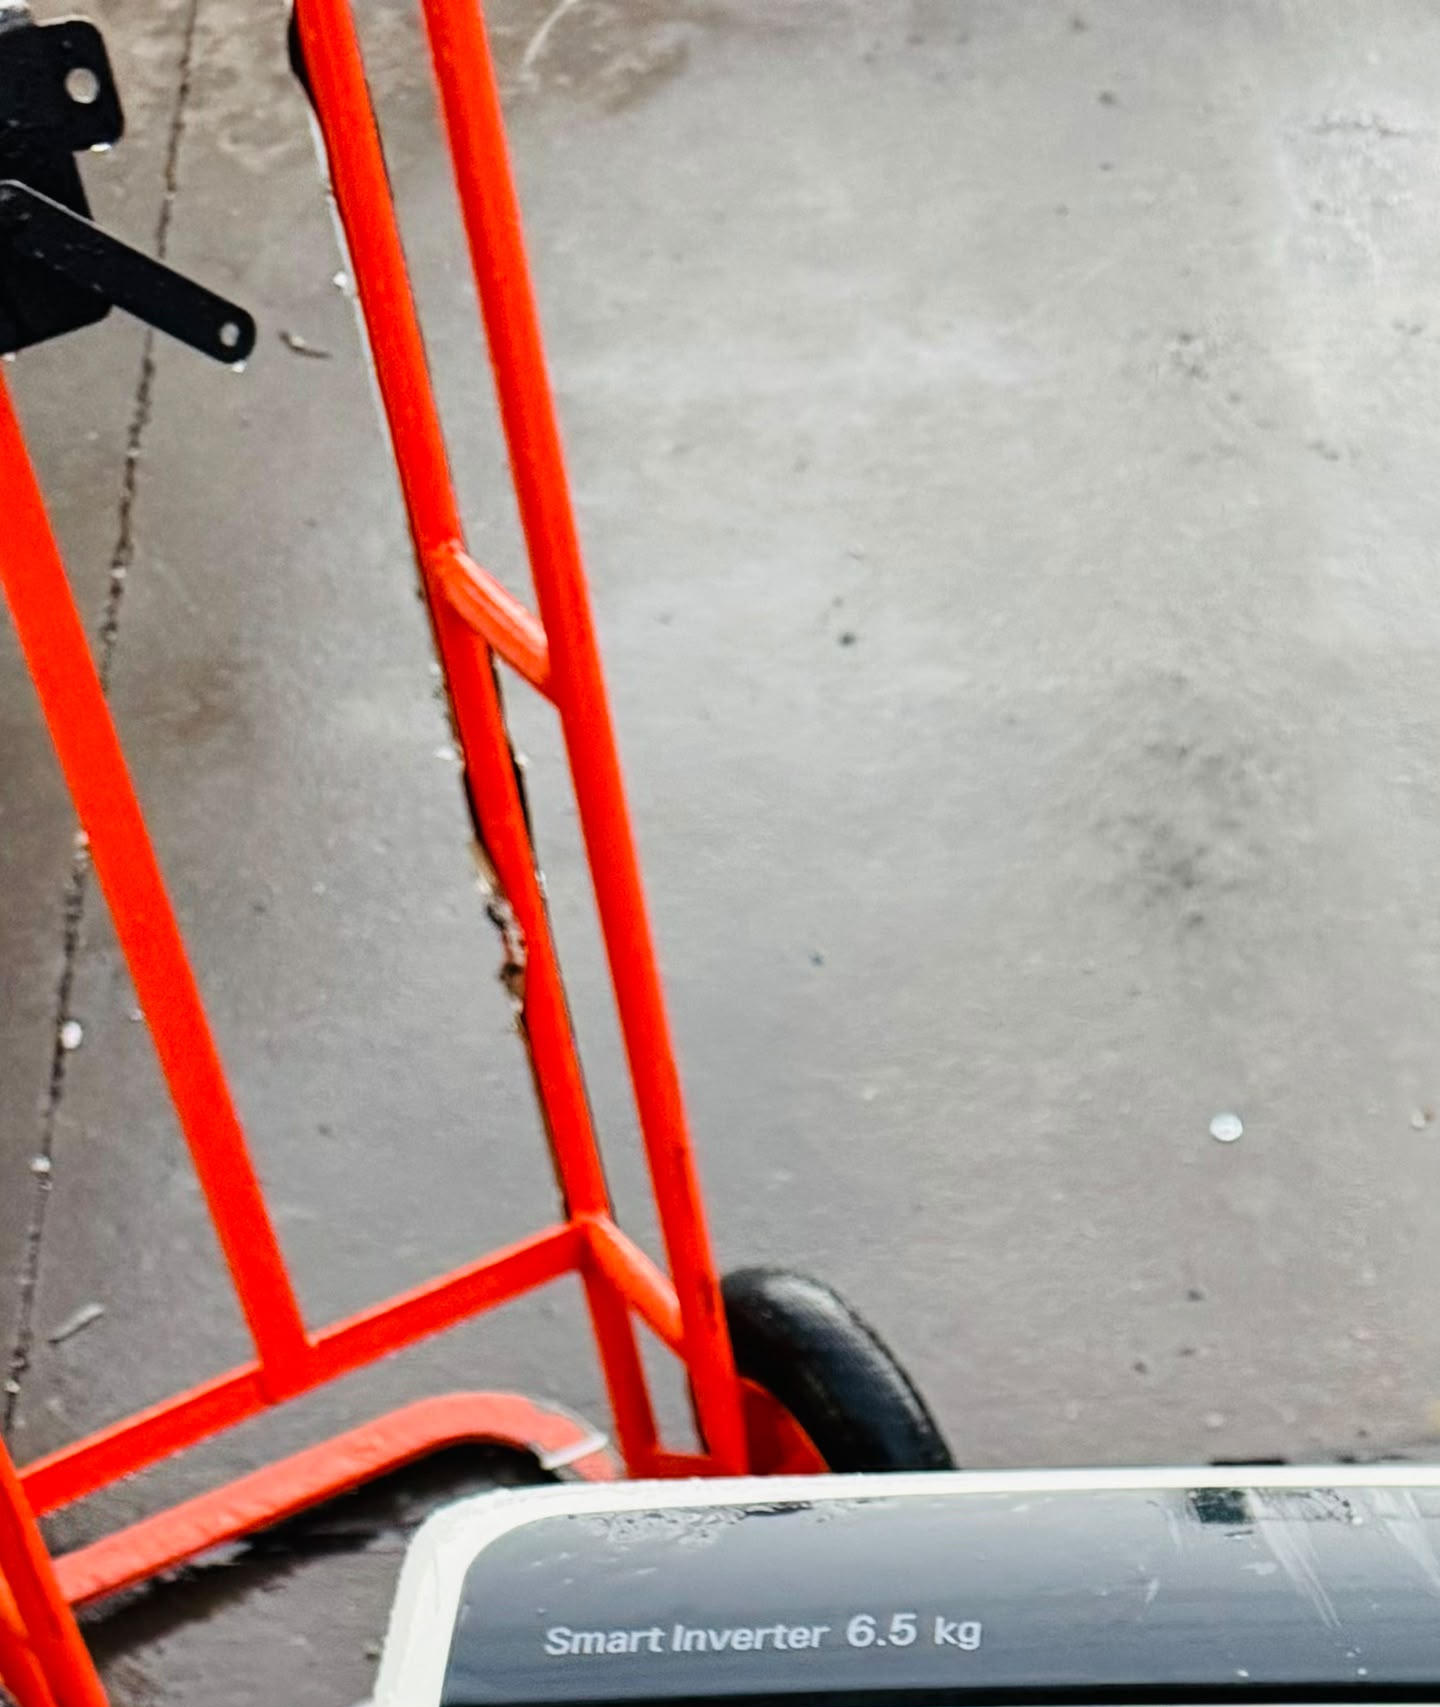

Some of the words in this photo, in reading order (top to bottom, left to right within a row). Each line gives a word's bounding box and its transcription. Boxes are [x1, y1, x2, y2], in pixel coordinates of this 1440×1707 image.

[544, 1626, 664, 1656] Smart
[673, 1622, 831, 1652] Inverter
[847, 1614, 918, 1648] 6.5
[934, 1615, 982, 1651] kg
